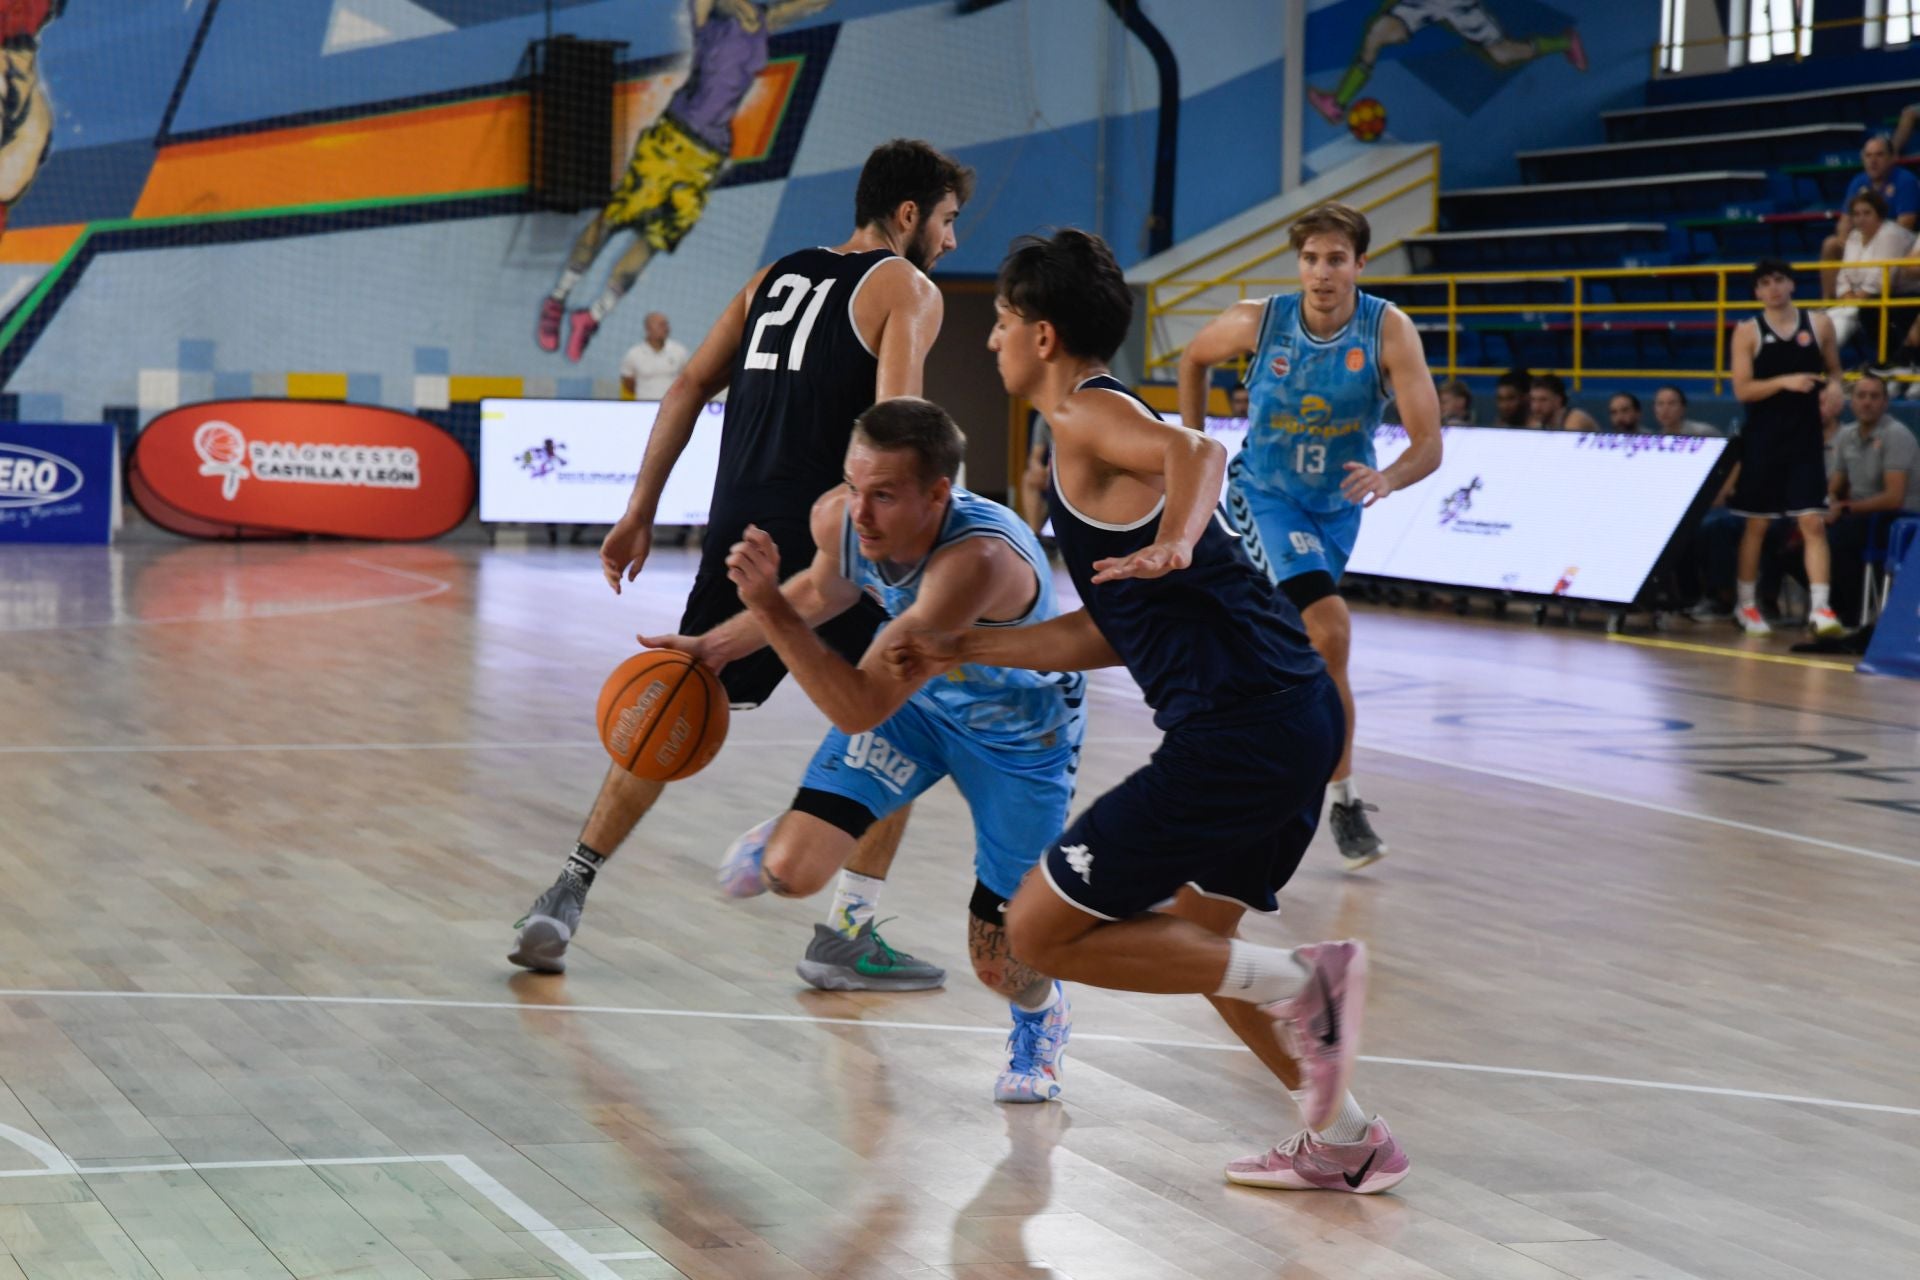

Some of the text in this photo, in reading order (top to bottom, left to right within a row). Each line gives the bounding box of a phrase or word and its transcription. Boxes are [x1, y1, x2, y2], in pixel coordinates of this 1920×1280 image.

[743, 273, 837, 371] 21
[253, 447, 414, 467] BALONCESTO
[257, 462, 415, 482] CASTILLA Y LEÓN
[1296, 443, 1326, 474] 13
[843, 731, 918, 787] gaza
